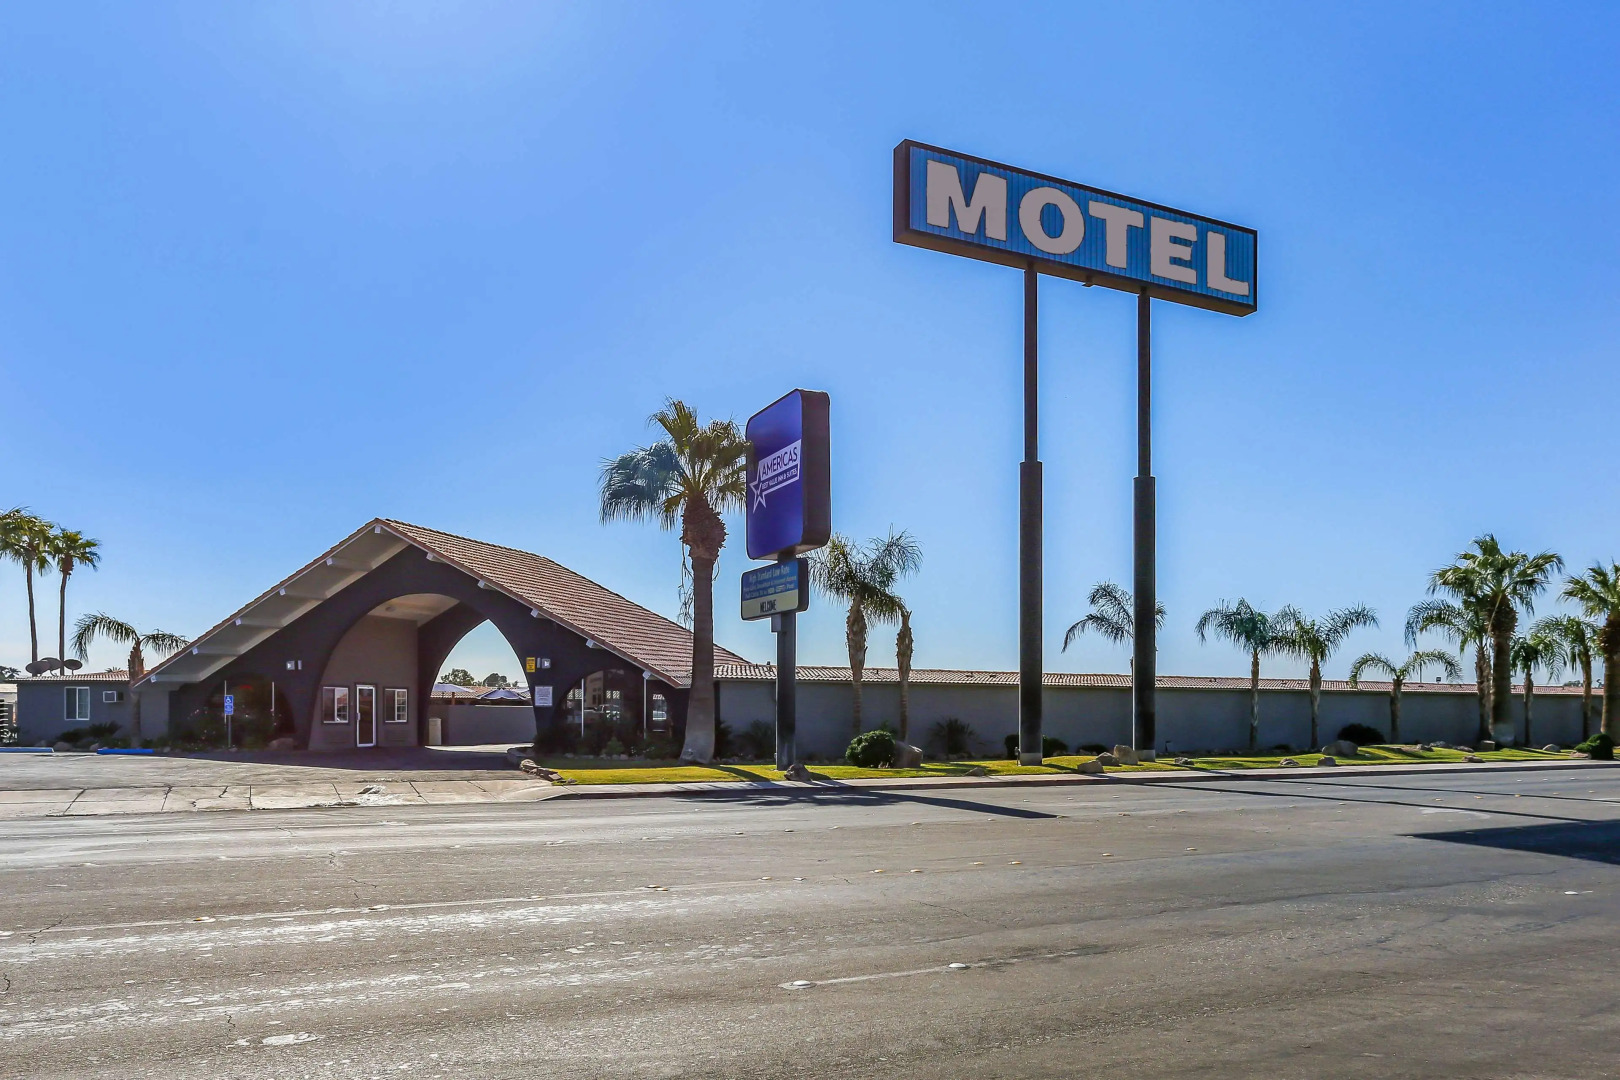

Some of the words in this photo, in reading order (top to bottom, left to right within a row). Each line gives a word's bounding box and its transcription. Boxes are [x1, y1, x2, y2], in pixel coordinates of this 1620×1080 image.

[926, 159, 1250, 297] MOTEL
[762, 446, 798, 477] AMERICAS
[787, 468, 797, 478] SUITES
[760, 599, 776, 613] WELCOME
